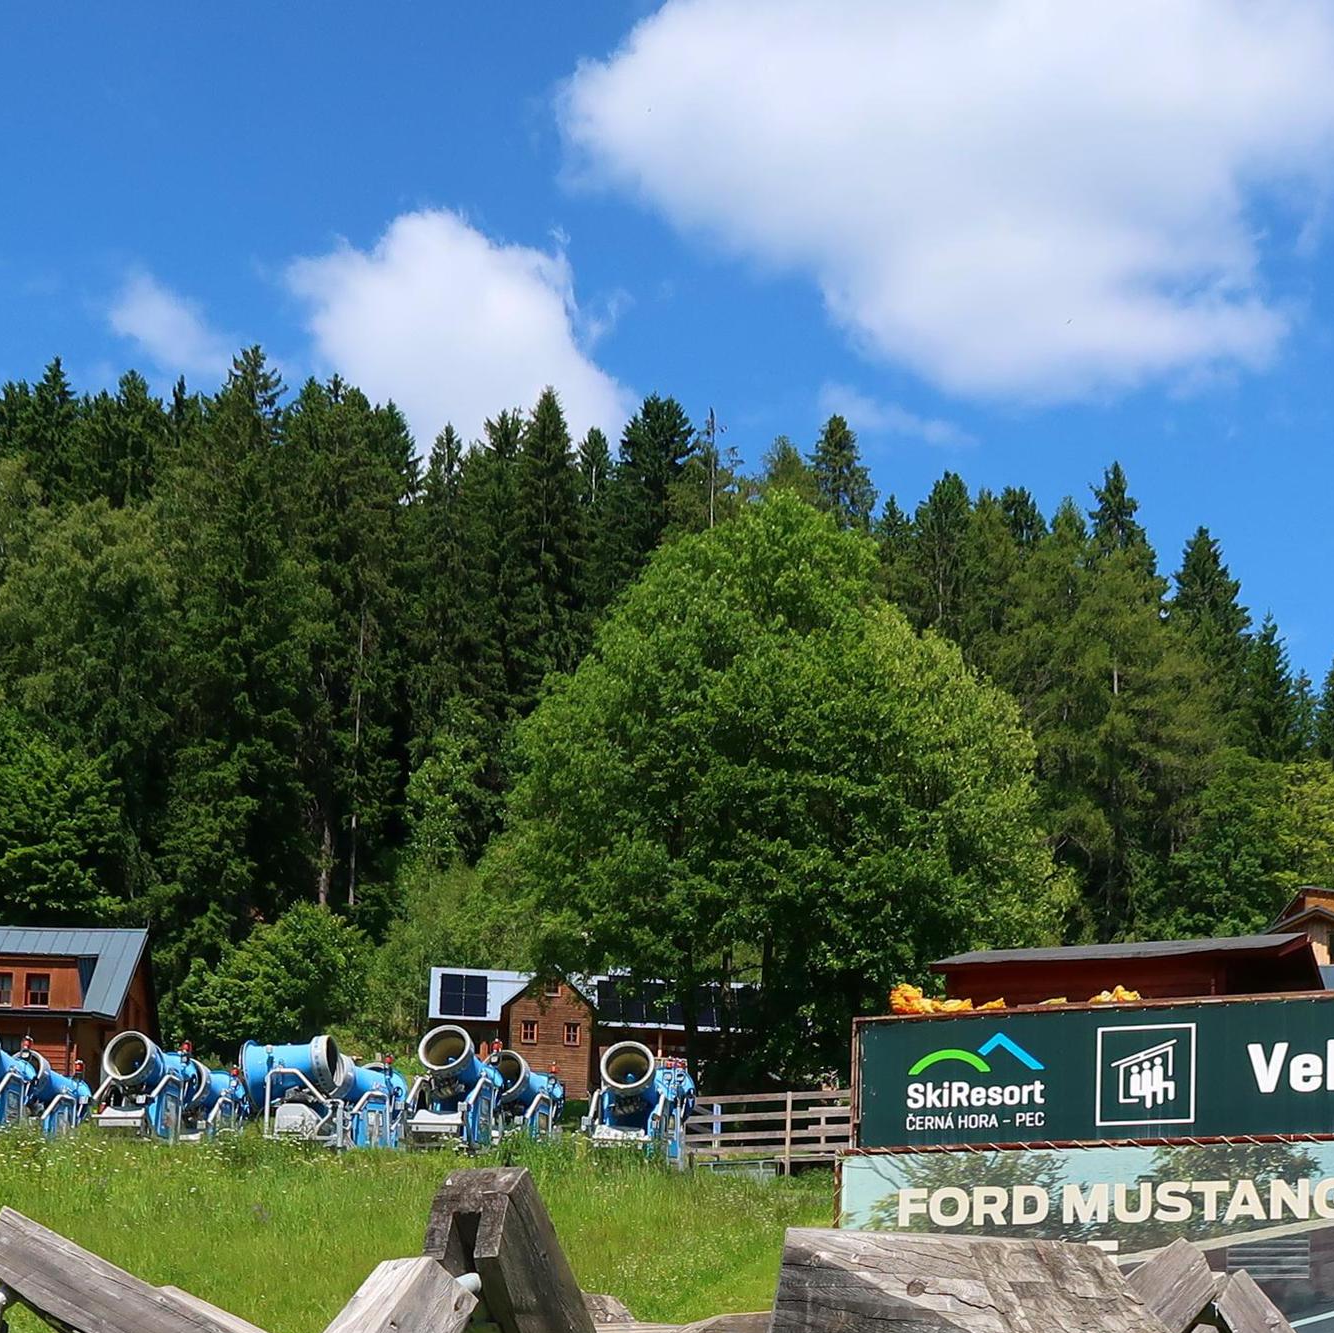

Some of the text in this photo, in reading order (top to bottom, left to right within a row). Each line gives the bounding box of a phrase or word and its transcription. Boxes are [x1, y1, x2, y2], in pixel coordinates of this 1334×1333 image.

[906, 1080, 1045, 1109] SkiResort
[905, 1112, 955, 1131] ČERNÁ
[958, 1113, 999, 1129] HORA
[1015, 1111, 1045, 1127] PEC
[897, 1185, 1050, 1228] FORD
